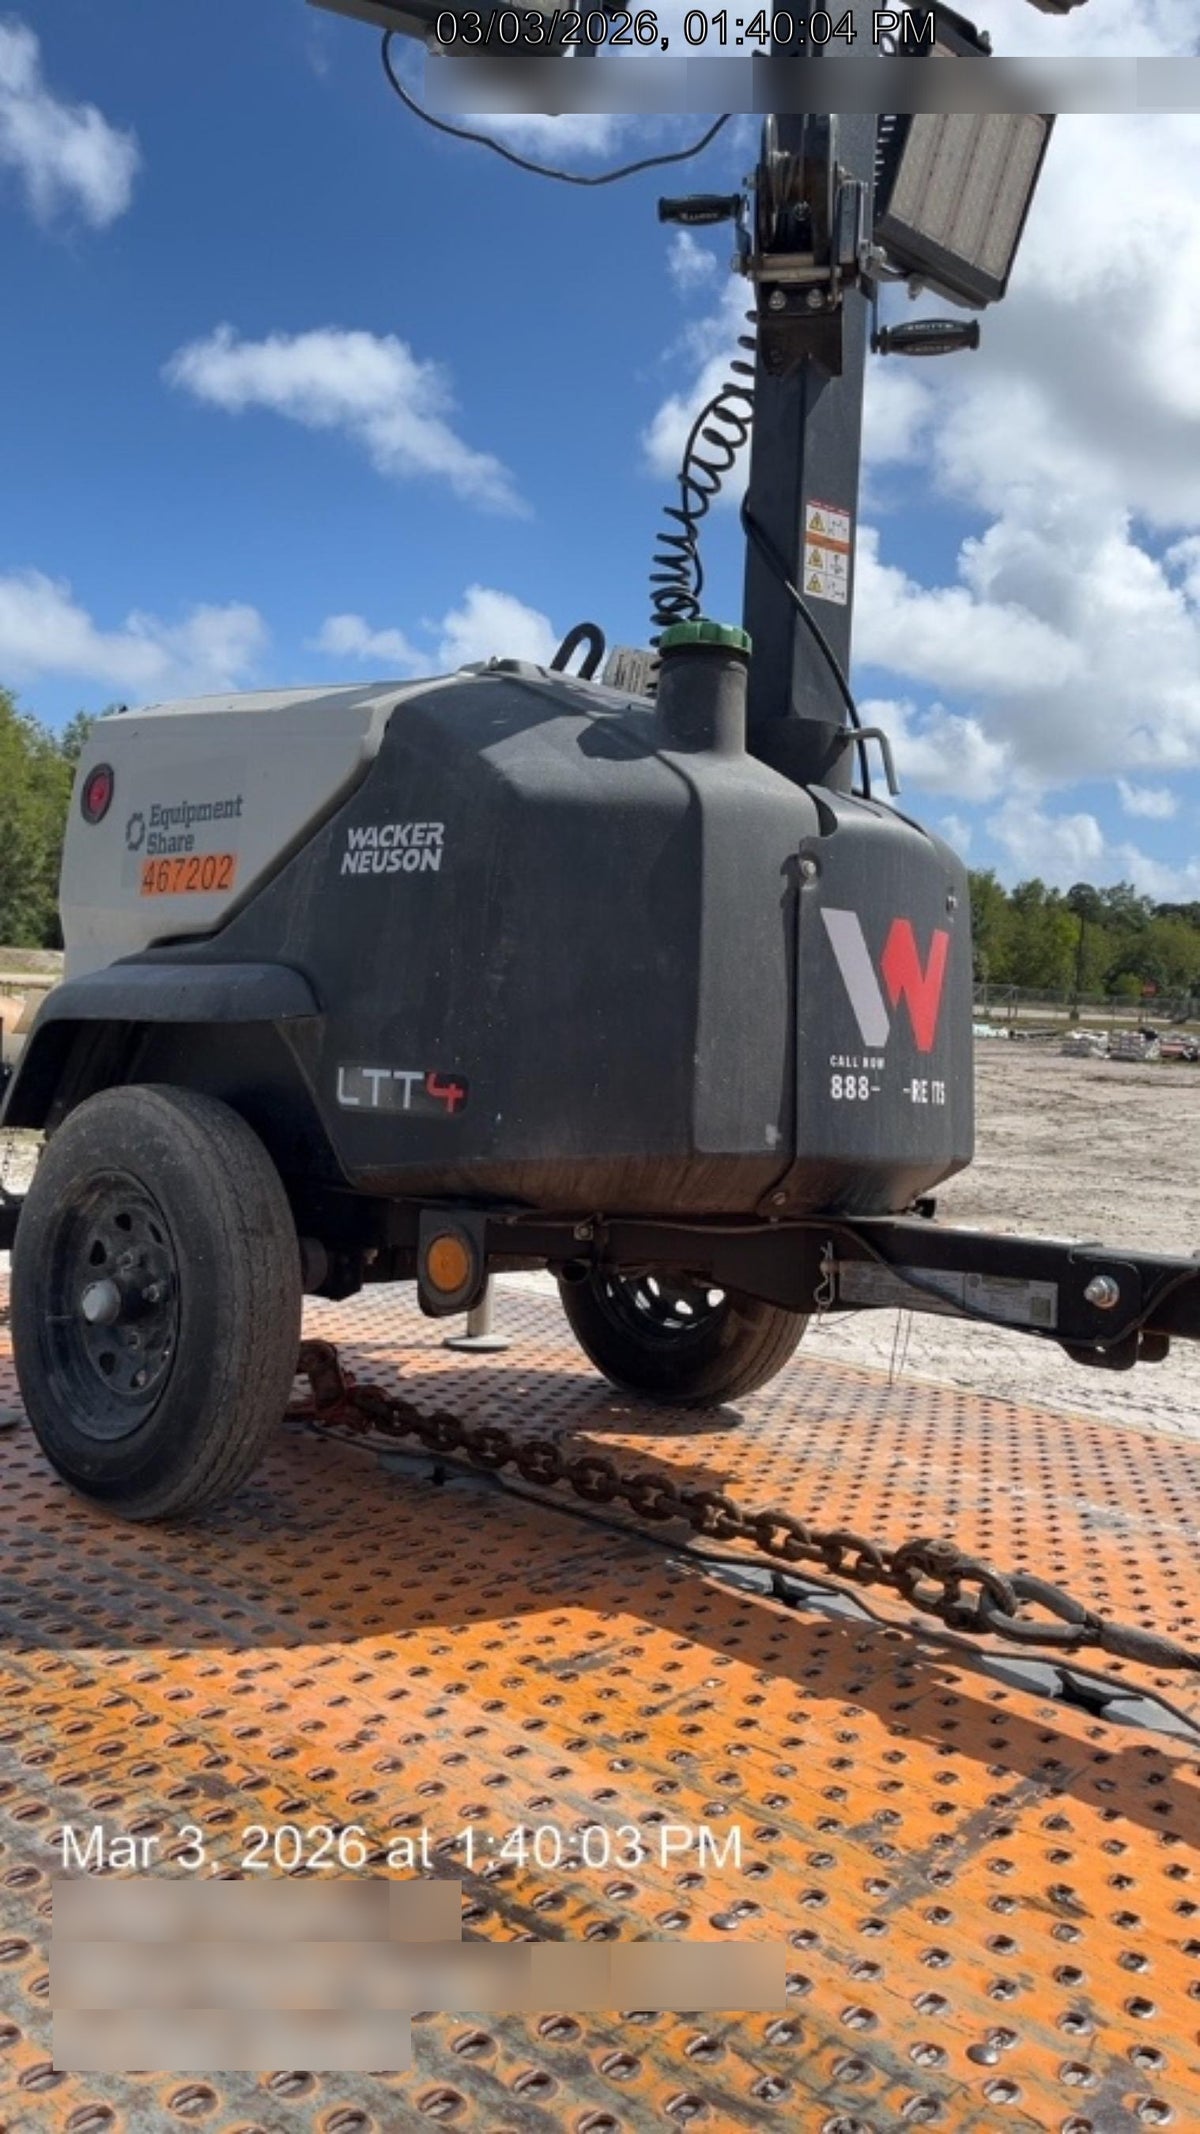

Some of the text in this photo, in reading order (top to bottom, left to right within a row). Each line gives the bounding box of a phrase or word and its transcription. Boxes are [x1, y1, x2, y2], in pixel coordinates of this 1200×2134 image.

[149, 795, 243, 829] Equipment
[146, 832, 194, 854] Share
[347, 822, 445, 850] WACKER
[142, 854, 233, 893] 467202
[340, 848, 443, 875] NEUSON
[830, 1055, 885, 1069] CALL NOW
[337, 1066, 464, 1112] LTT4
